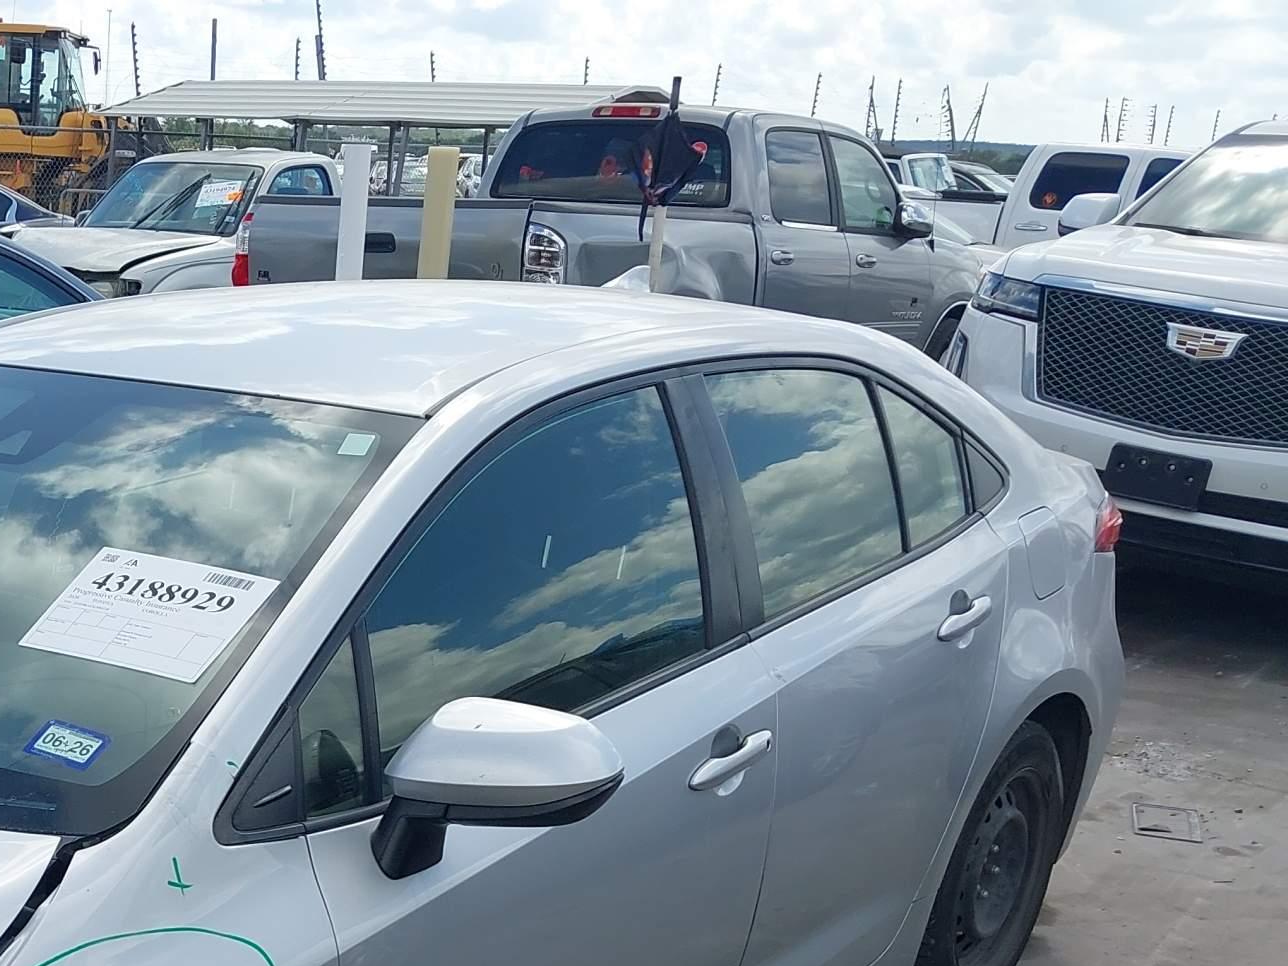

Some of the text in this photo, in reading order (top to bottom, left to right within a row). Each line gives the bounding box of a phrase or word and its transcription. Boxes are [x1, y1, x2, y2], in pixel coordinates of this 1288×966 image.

[91, 572, 235, 614] 43188929
[113, 594, 144, 606] Casualty
[145, 600, 181, 613] Insurance
